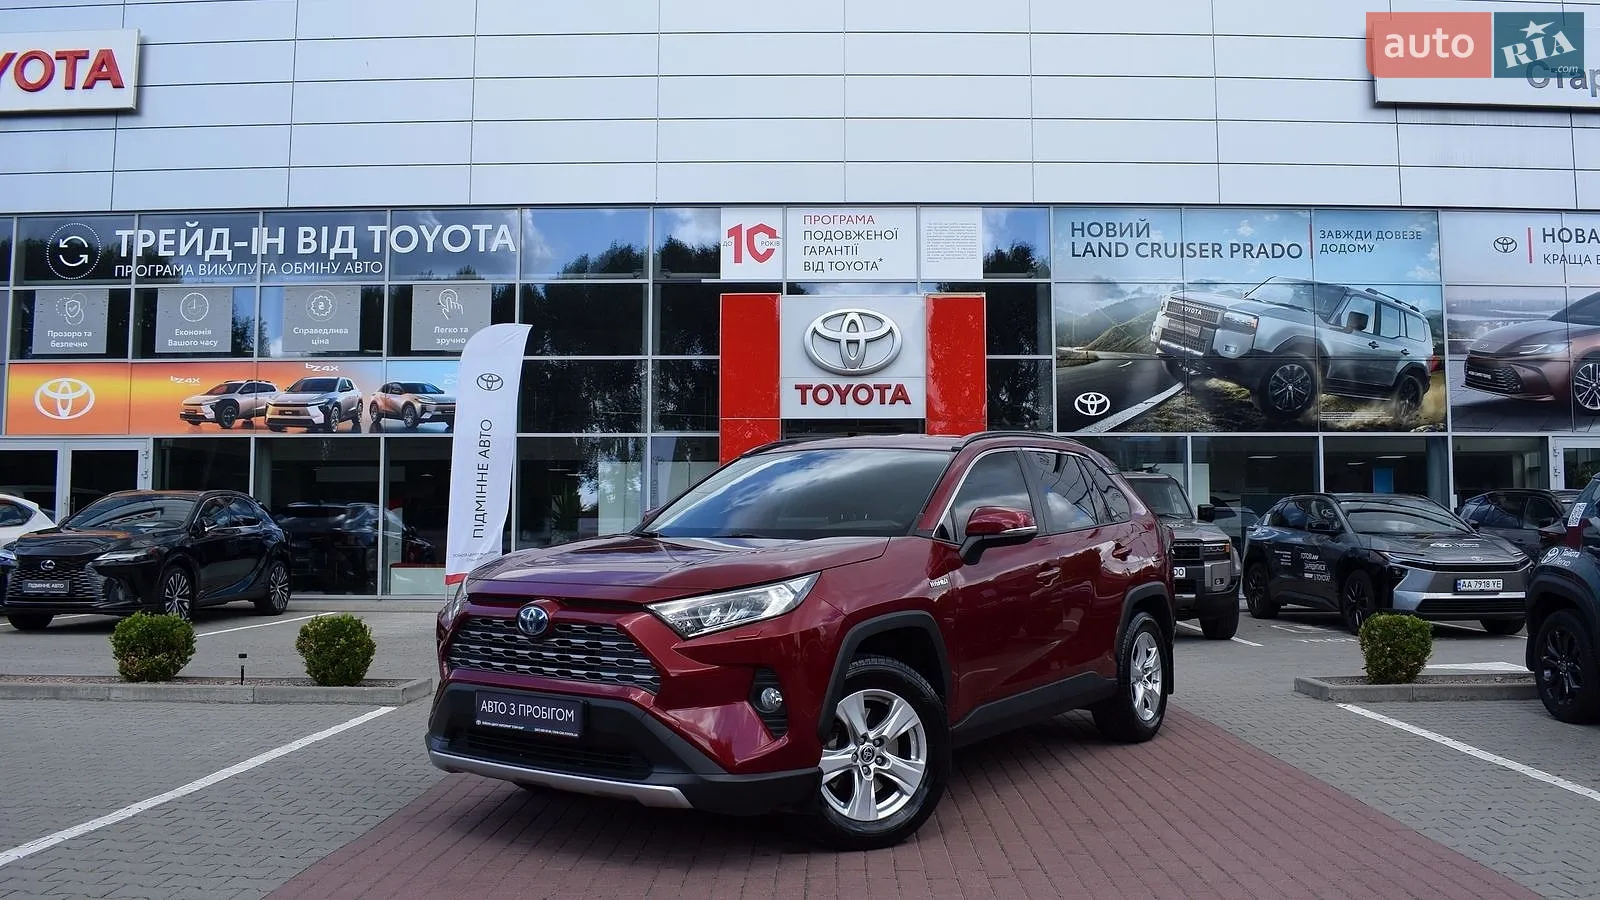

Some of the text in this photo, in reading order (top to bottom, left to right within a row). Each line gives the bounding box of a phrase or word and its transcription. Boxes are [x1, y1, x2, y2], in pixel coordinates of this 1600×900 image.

[803, 214, 875, 225] ПРОГРАМА
[1071, 218, 1151, 238] НОВИЙ
[115, 220, 516, 262] ТРЕЙД-ІН ВІД TOYOTA
[803, 228, 899, 242] ПОДОВЖЕНОЇ
[1319, 229, 1422, 241] ЗАВЖДИ ДОВЕЗЕ
[1542, 227, 1600, 244] НОВА
[803, 243, 859, 256] ГАРАНТІЇ
[1071, 241, 1303, 260] LAND CRUISER PRADO
[1319, 243, 1375, 255] ДОДОМУ
[1543, 253, 1592, 267] КРАЩА
[114, 260, 383, 277] ПРОГРАМА ВИКУПУ ТА ОБМІНУ АВТО
[803, 260, 825, 273] ВІД
[47, 330, 82, 340] Прозоро
[175, 328, 212, 336] Економія
[293, 326, 349, 336] Справедлива
[433, 326, 457, 335] Легко
[50, 340, 88, 348] безпечно
[167, 339, 199, 347] Вашого
[311, 336, 330, 346] ціна
[435, 337, 467, 346] зручно
[794, 383, 912, 406] TOYOTA
[472, 419, 493, 539] ПІДМІННЕ АВТО
[1462, 580, 1472, 589] AA
[1474, 580, 1490, 589] 7918
[480, 699, 507, 715] АВТО
[518, 703, 575, 722] ПРОБІГОМ
